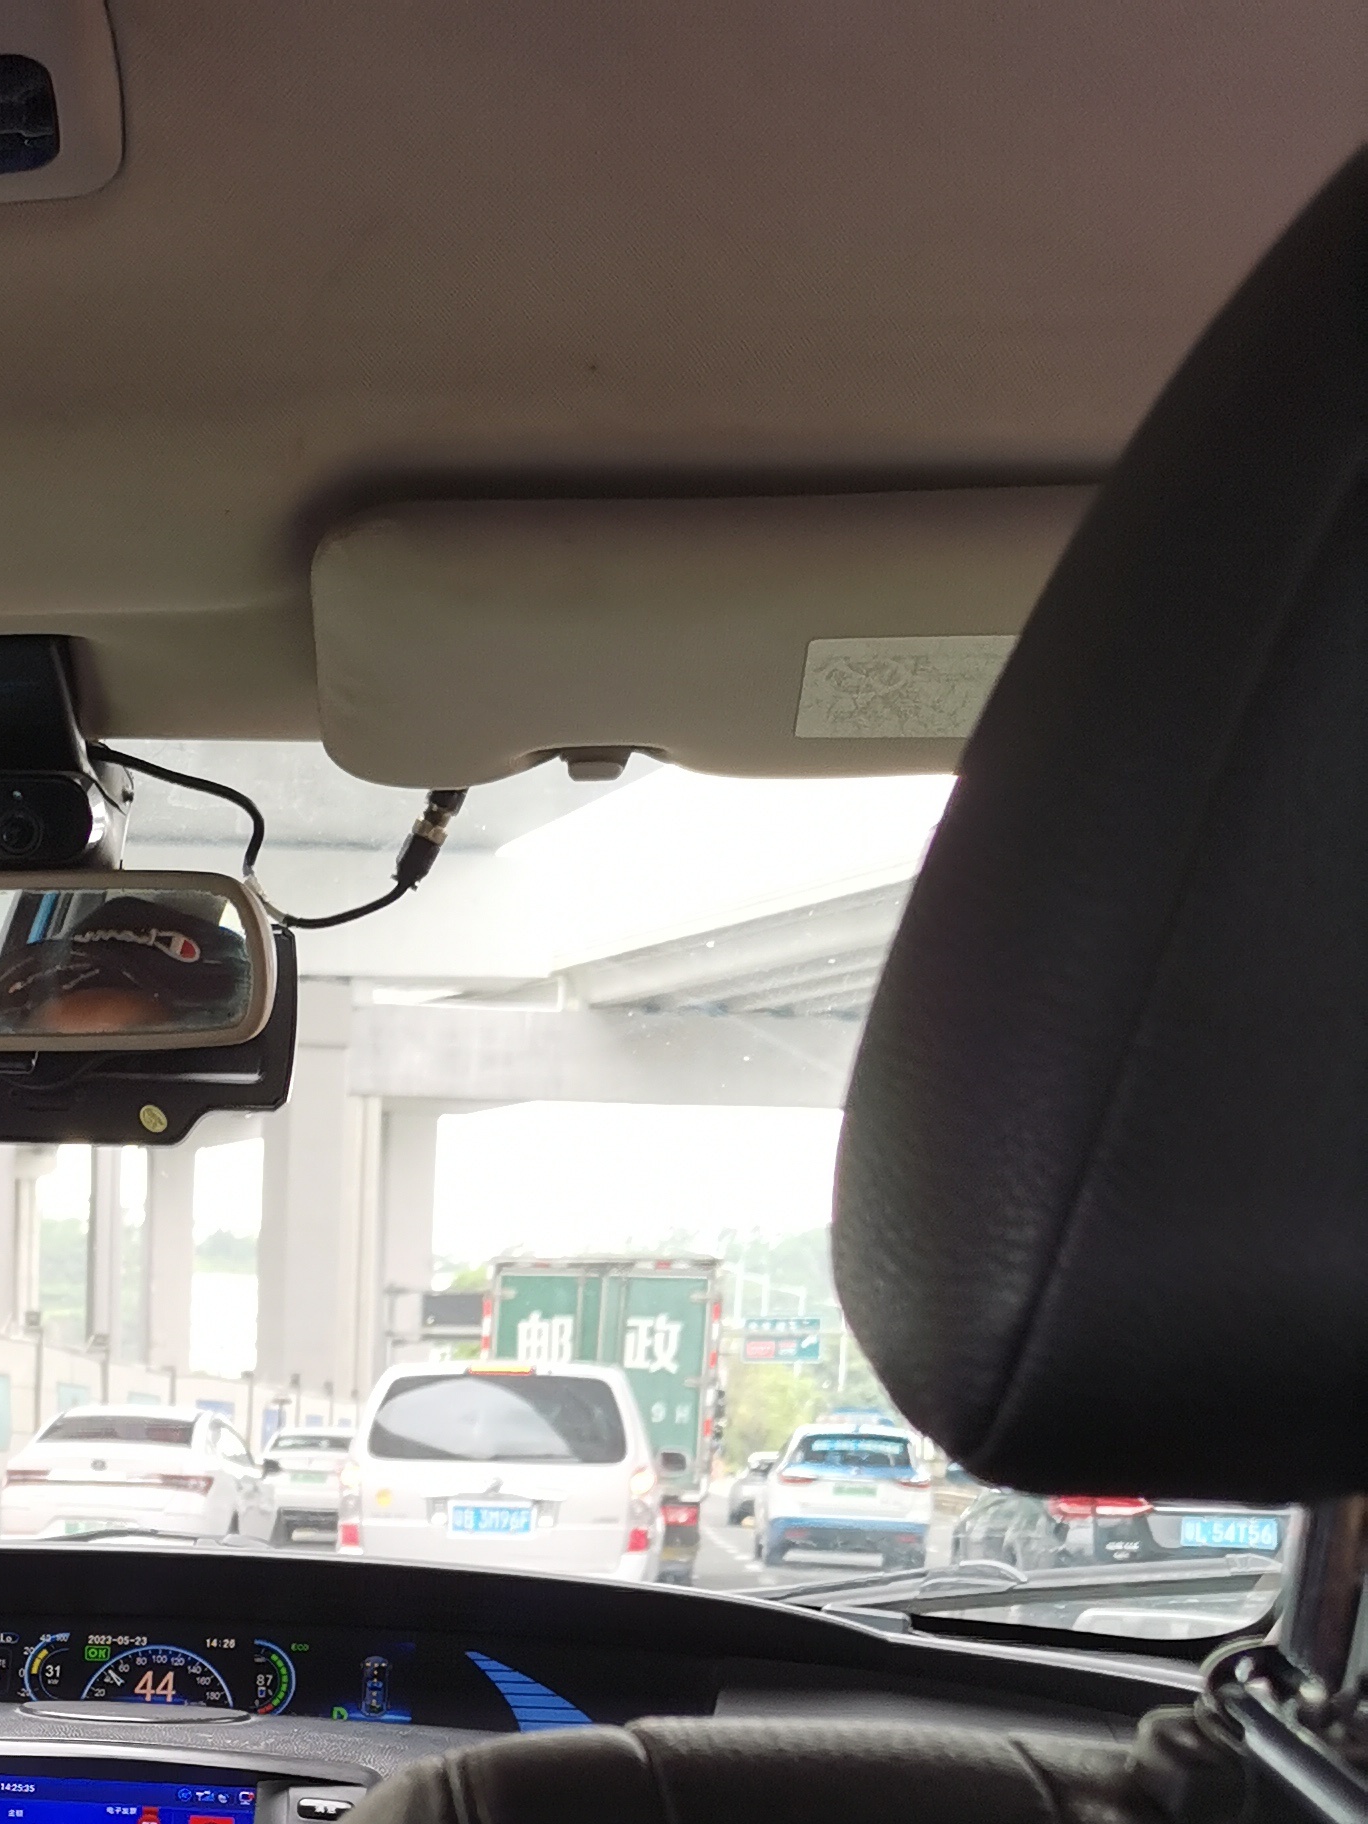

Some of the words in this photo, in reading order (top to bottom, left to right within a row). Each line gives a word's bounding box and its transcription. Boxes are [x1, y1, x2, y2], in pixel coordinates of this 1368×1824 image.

[515, 1309, 683, 1374] 邮政
[87, 1635, 148, 1646] 2023-05-23
[88, 1649, 107, 1658] OK
[152, 1654, 168, 1664] 100
[136, 1656, 148, 1666] 80
[170, 1656, 185, 1666] 120
[45, 1665, 61, 1678] 31
[188, 1664, 202, 1675] 140
[256, 1674, 273, 1686] 87
[134, 1670, 176, 1702] 44
[94, 1687, 106, 1697] 20
[0, 1782, 36, 1793] 14:25:35
